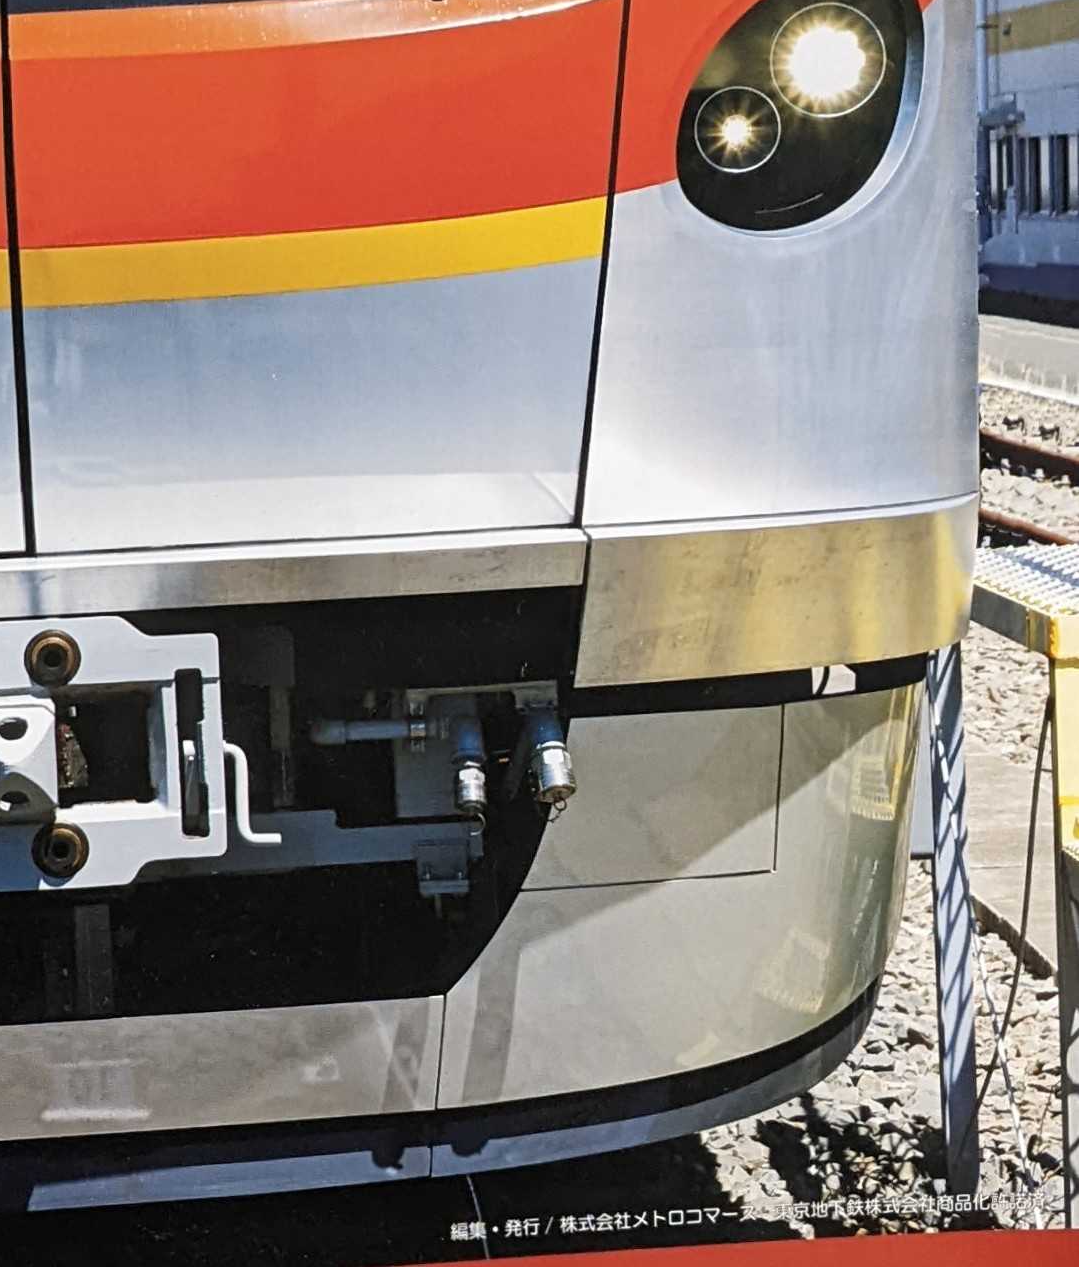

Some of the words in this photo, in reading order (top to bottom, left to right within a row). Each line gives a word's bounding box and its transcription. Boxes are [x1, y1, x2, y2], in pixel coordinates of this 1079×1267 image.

[450, 1216, 541, 1242] 編集・発行
[559, 1204, 757, 1234] 株式会社メトロコマース
